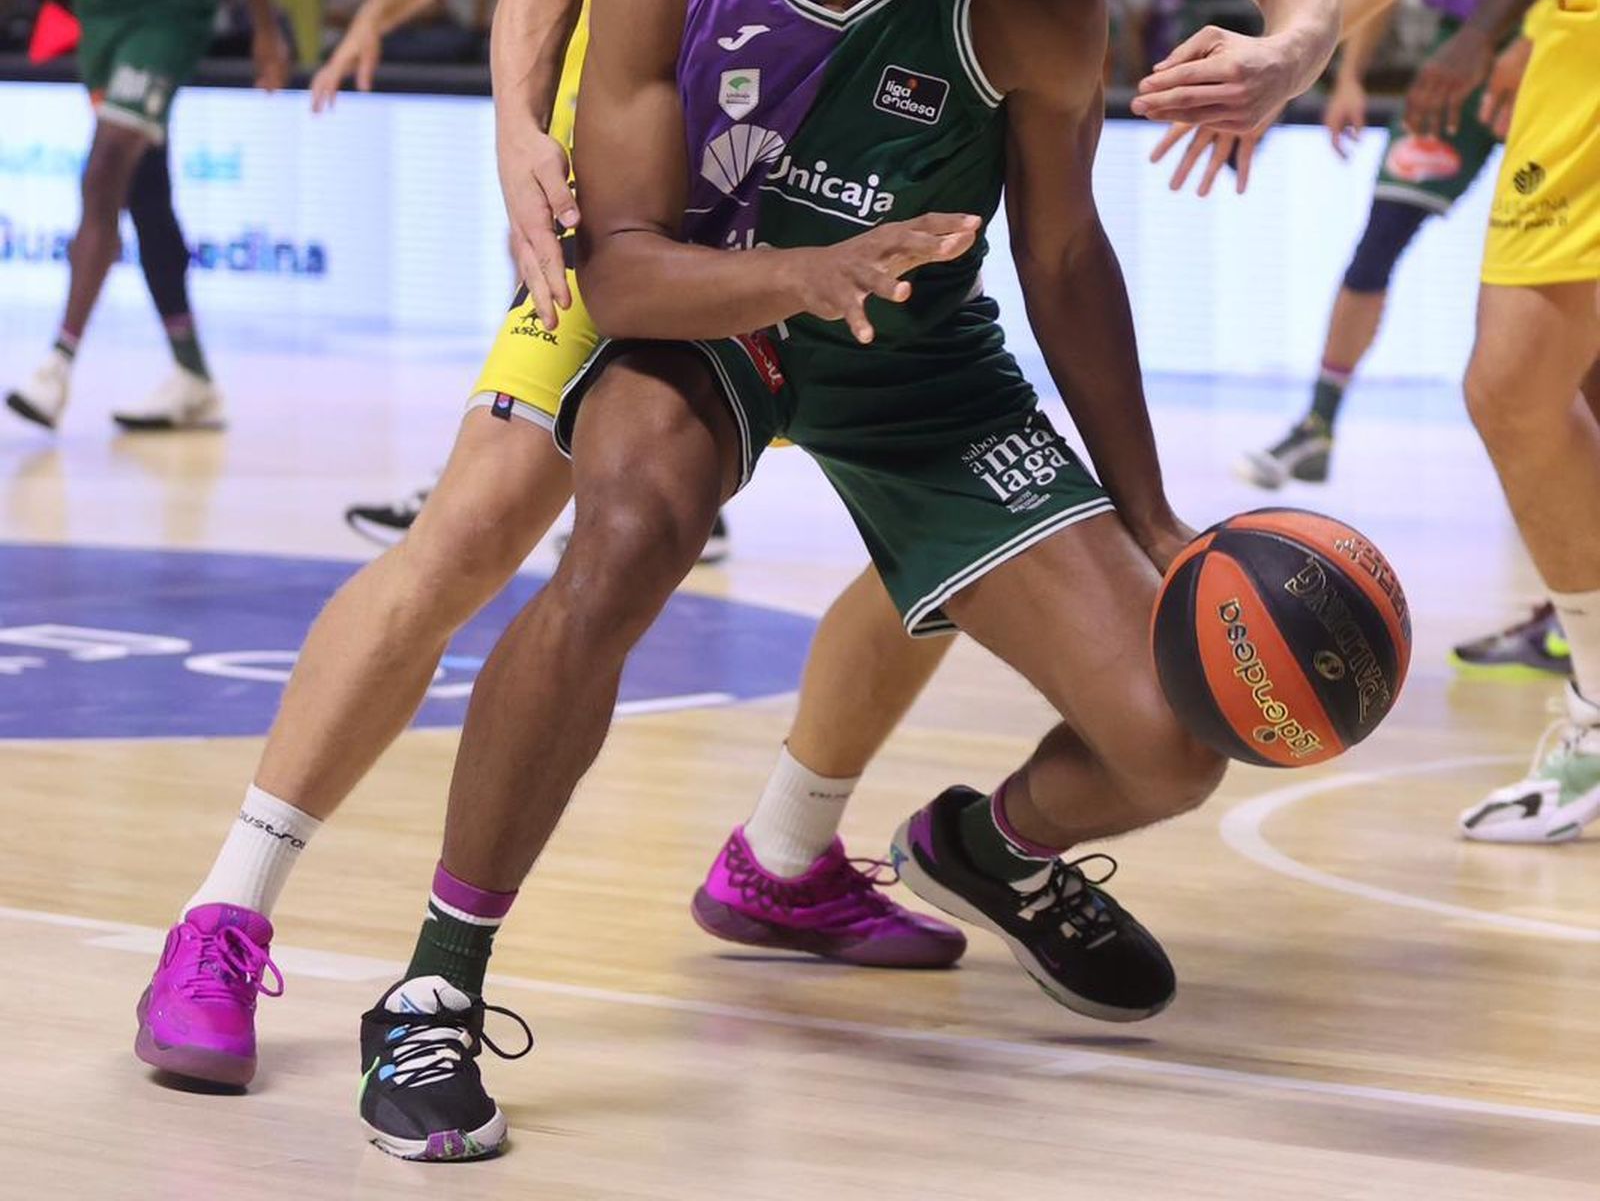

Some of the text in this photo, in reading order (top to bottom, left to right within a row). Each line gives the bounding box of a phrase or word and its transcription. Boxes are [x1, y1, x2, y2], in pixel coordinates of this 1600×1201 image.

[885, 80, 912, 98] liga
[881, 94, 936, 117] endesa
[765, 155, 895, 217] Unicaja
